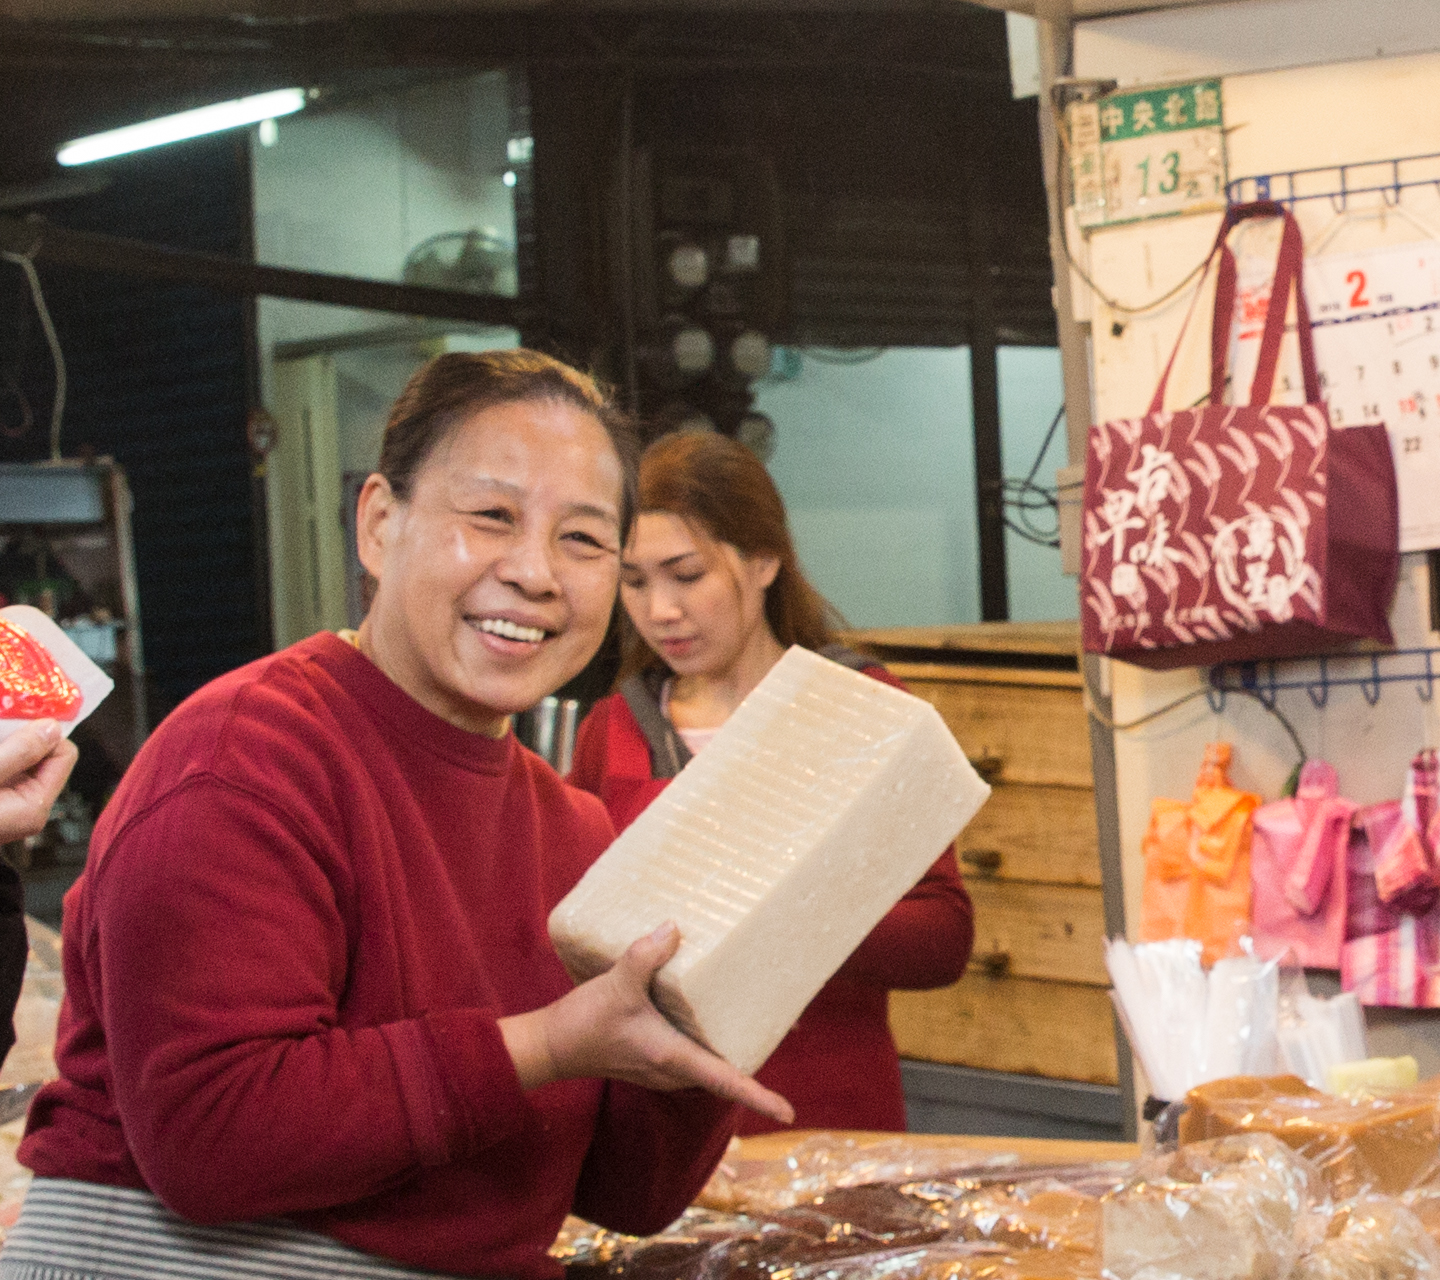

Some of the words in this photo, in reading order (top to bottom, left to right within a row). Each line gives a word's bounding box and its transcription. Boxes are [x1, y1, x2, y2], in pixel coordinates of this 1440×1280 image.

[1100, 89, 1220, 137] 中央北路
[1136, 150, 1181, 197] 13
[1345, 270, 1370, 309] 2
